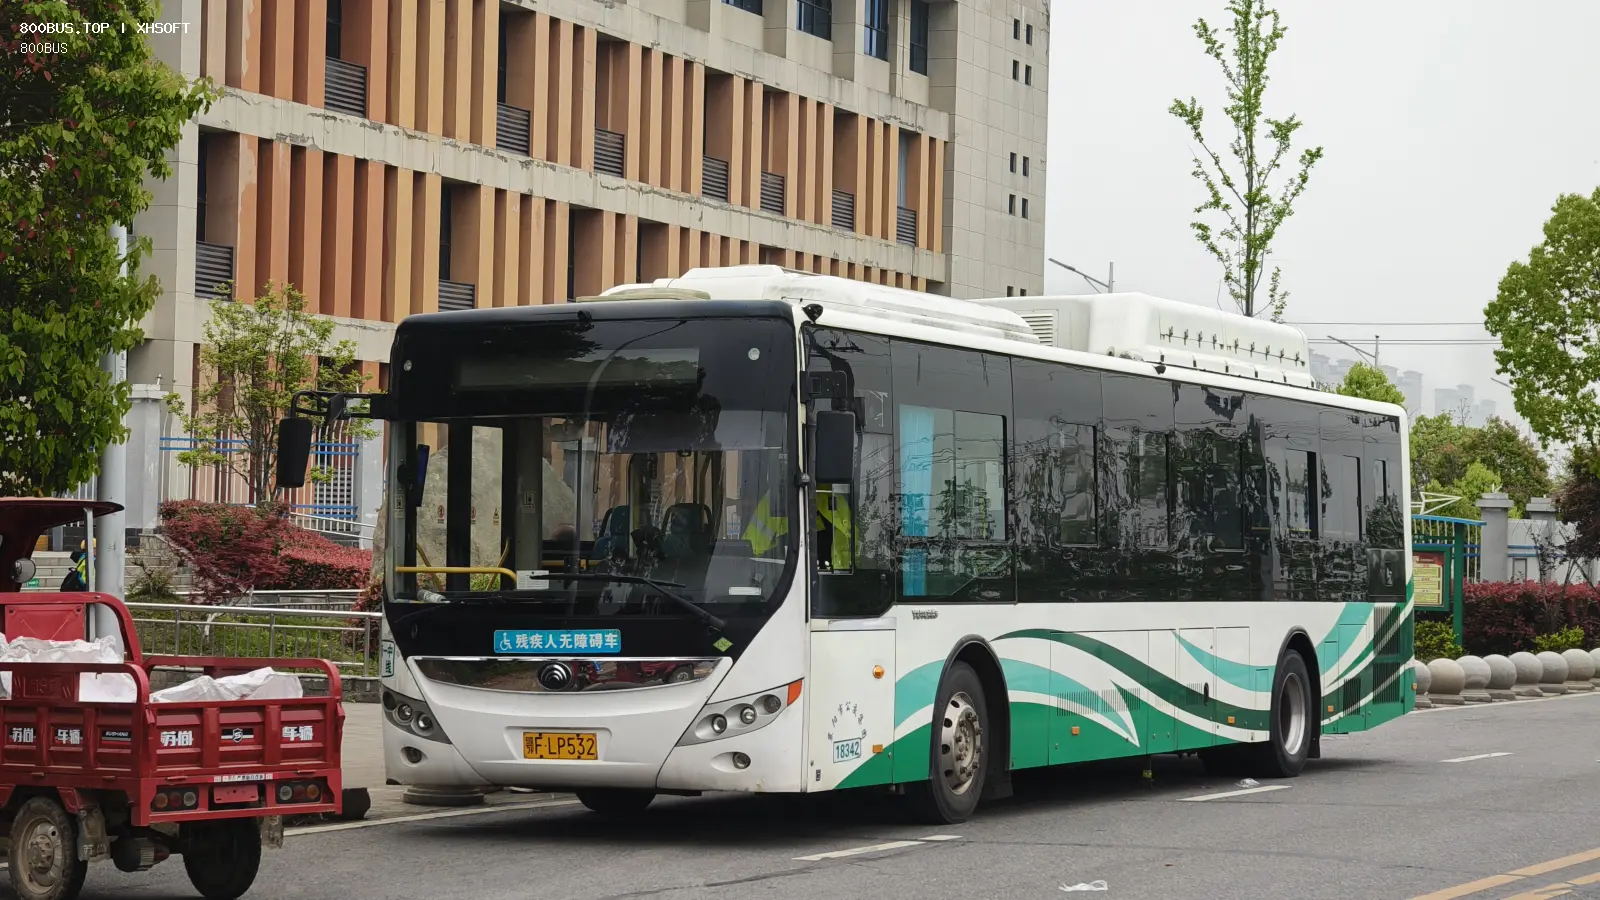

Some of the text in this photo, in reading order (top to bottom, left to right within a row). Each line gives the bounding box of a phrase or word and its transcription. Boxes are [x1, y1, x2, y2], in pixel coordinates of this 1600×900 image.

[515, 632, 619, 650] 残疾人无障碍车
[12, 727, 34, 743] 苏尚
[57, 729, 81, 745] 车辆
[160, 730, 193, 747] 苏尚
[282, 725, 314, 741] 车辆
[836, 741, 860, 759] 18342
